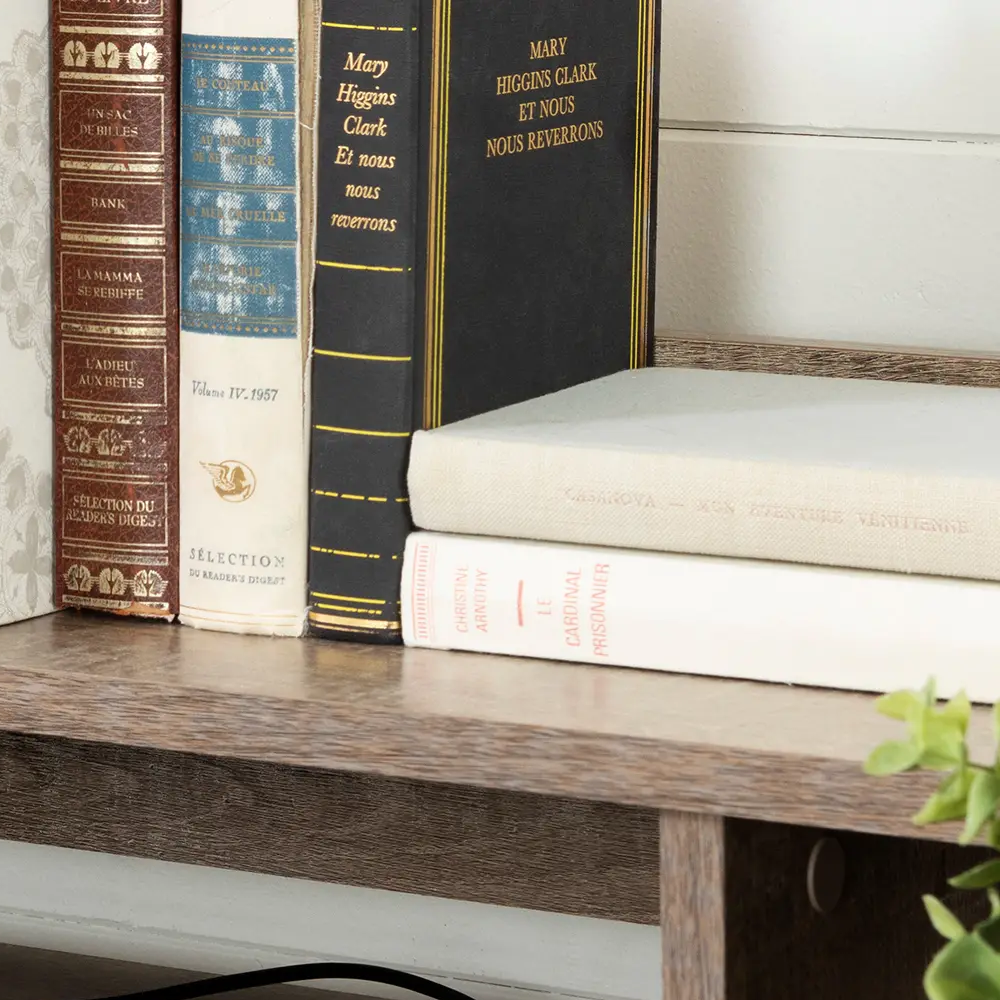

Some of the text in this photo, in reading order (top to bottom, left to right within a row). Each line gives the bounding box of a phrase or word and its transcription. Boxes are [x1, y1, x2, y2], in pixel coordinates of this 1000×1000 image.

[529, 37, 568, 60] MARY
[343, 52, 389, 78] Mary
[496, 62, 598, 95] HIGGINS CLARK
[336, 82, 397, 110] Higgins
[87, 108, 132, 120] UN SAC
[518, 95, 575, 122] ET NOUS
[80, 124, 139, 137] DE BILLES
[343, 115, 388, 137] Clark
[486, 120, 604, 158] NOUS REVERRONS
[334, 145, 396, 169] Et nous
[345, 183, 381, 200] nous
[91, 197, 126, 209] BANK
[330, 213, 397, 232] reverrons
[78, 269, 143, 283] LA MAMMA
[78, 286, 144, 300] SE REBIFFE
[86, 358, 134, 372] L'ADIEU
[80, 374, 145, 389] AUX BÊTES
[192, 379, 225, 398] Volume
[72, 493, 155, 513] SÉLECTION DU
[563, 488, 656, 509] CASANOVA
[189, 547, 285, 568] SÉLECTION
[189, 568, 285, 585] DU READER'S DIGEST
[475, 567, 489, 633] ARNOTHY
[537, 597, 552, 616] LE
[563, 566, 582, 647] CARDINAL
[589, 563, 610, 657] PRISONNIER
